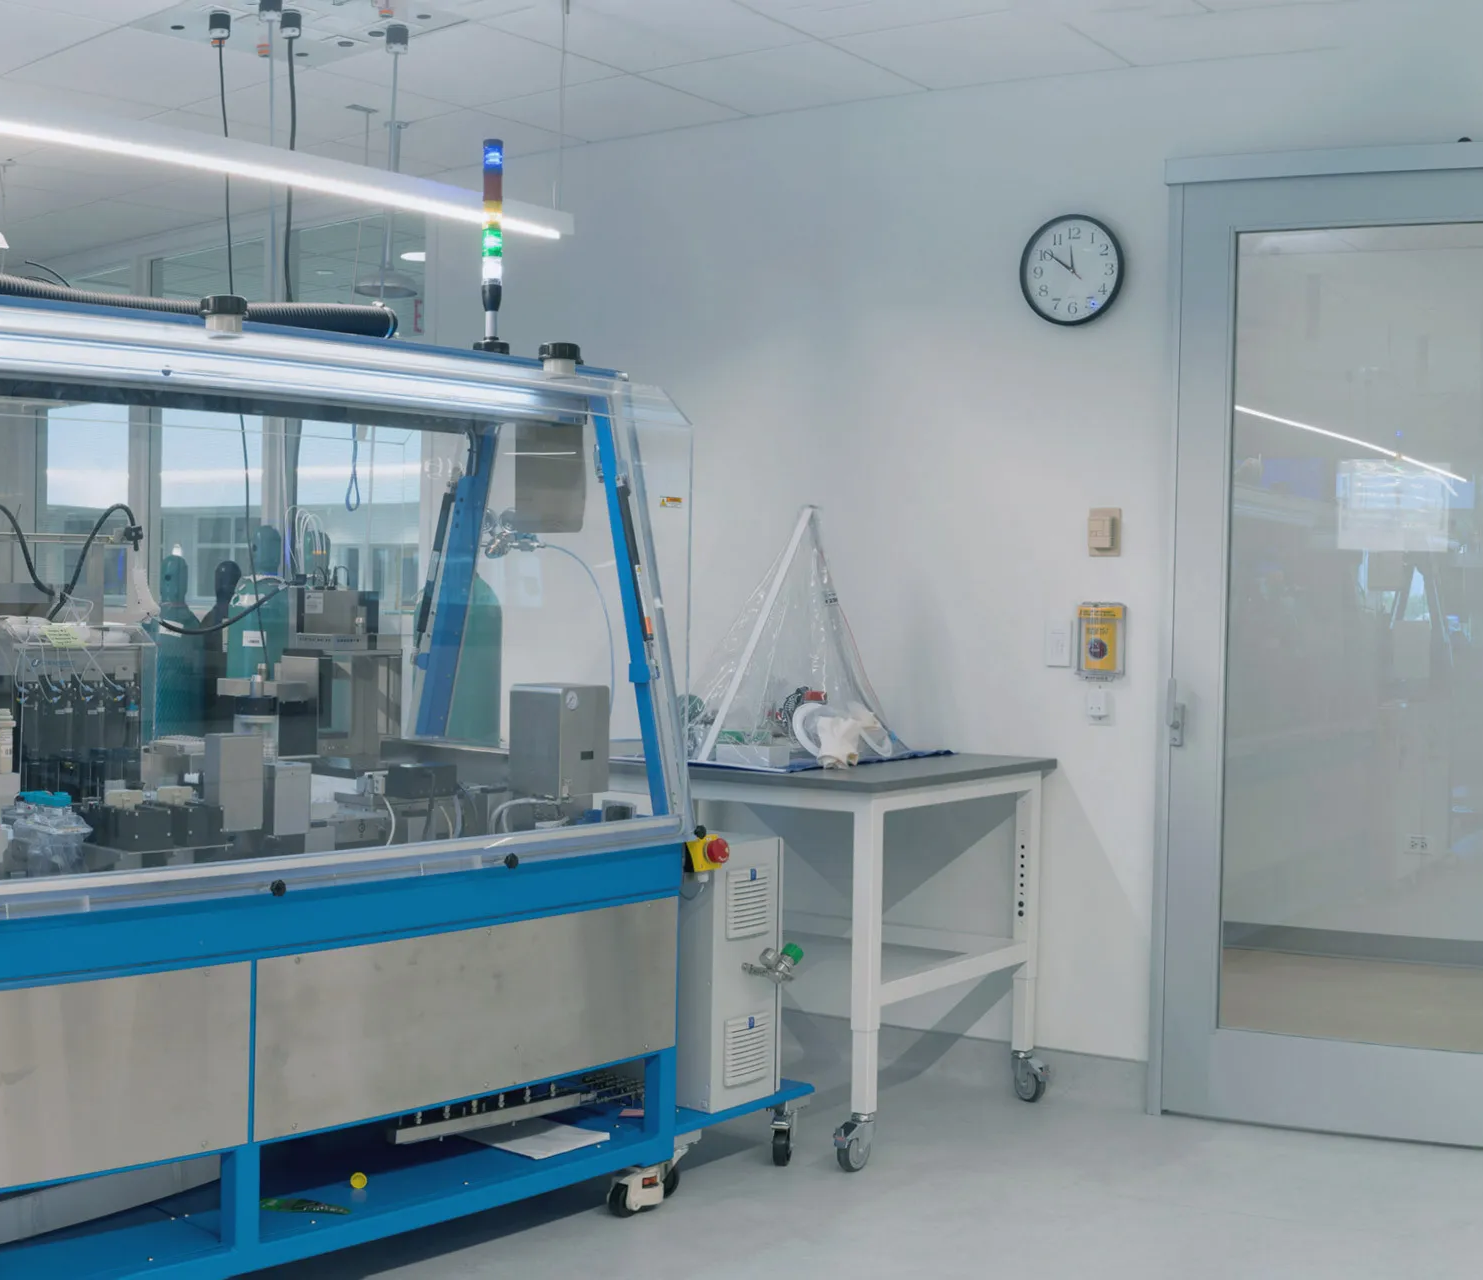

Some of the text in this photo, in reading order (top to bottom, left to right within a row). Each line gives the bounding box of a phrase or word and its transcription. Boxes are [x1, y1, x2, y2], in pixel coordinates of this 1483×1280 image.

[1068, 227, 1081, 240] 12
[1090, 232, 1095, 244] 1
[1053, 234, 1062, 246] 11
[1039, 249, 1054, 261] 10
[1099, 244, 1109, 256] 2
[1033, 266, 1044, 279] 9
[1104, 263, 1114, 276] 3
[1038, 284, 1049, 297] 8
[1098, 283, 1108, 295] 4
[1052, 298, 1061, 310] 7
[1067, 302, 1078, 315] 6
